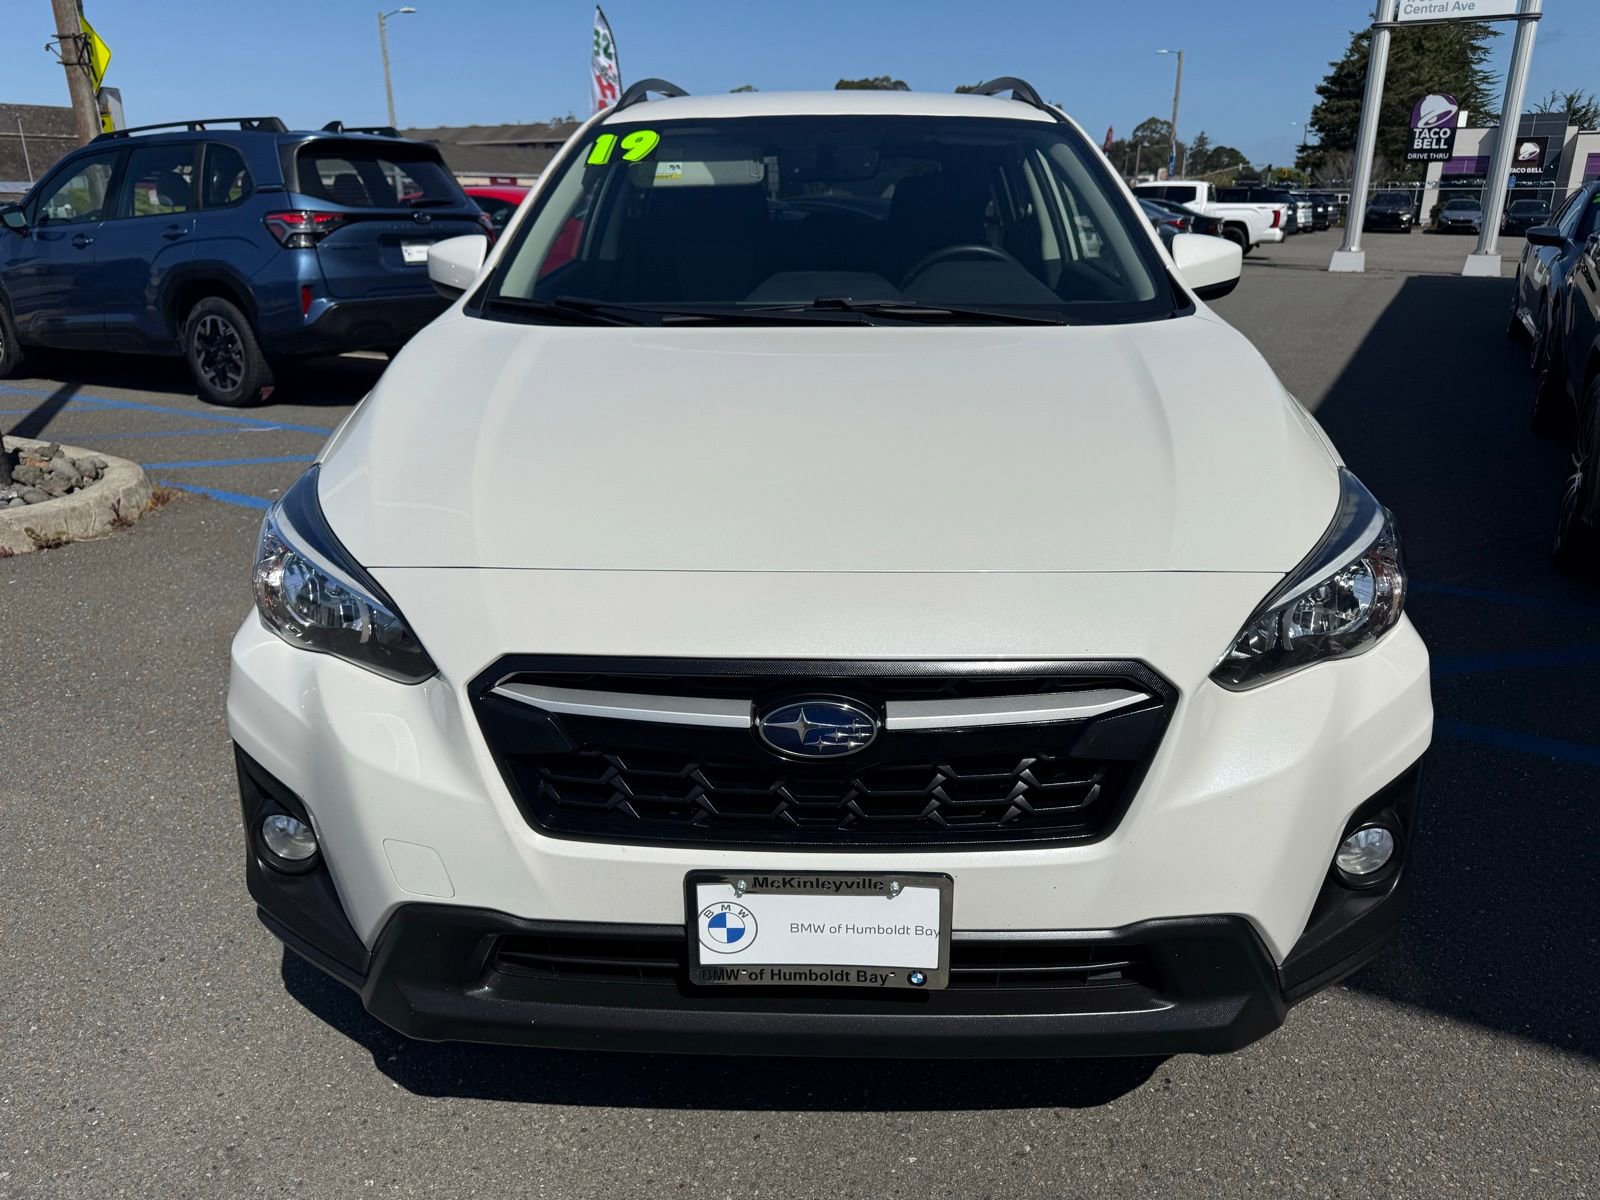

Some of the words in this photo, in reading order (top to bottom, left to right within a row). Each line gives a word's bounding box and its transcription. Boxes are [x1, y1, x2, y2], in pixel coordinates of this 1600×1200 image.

[1404, 2, 1448, 15] Central
[1451, 1, 1475, 11] Ave
[1413, 128, 1451, 139] TACO
[585, 130, 660, 166] 19
[1413, 139, 1448, 149] BELL
[752, 876, 884, 893] McKinleyville
[703, 904, 749, 919] BMW
[790, 923, 826, 934] BMW
[829, 923, 842, 934] of
[845, 924, 911, 936] Humboldt
[914, 926, 940, 938] Bay
[702, 969, 741, 982] BMW
[748, 968, 766, 981] of
[770, 968, 851, 983] Humboldt
[856, 970, 889, 986] Bay
